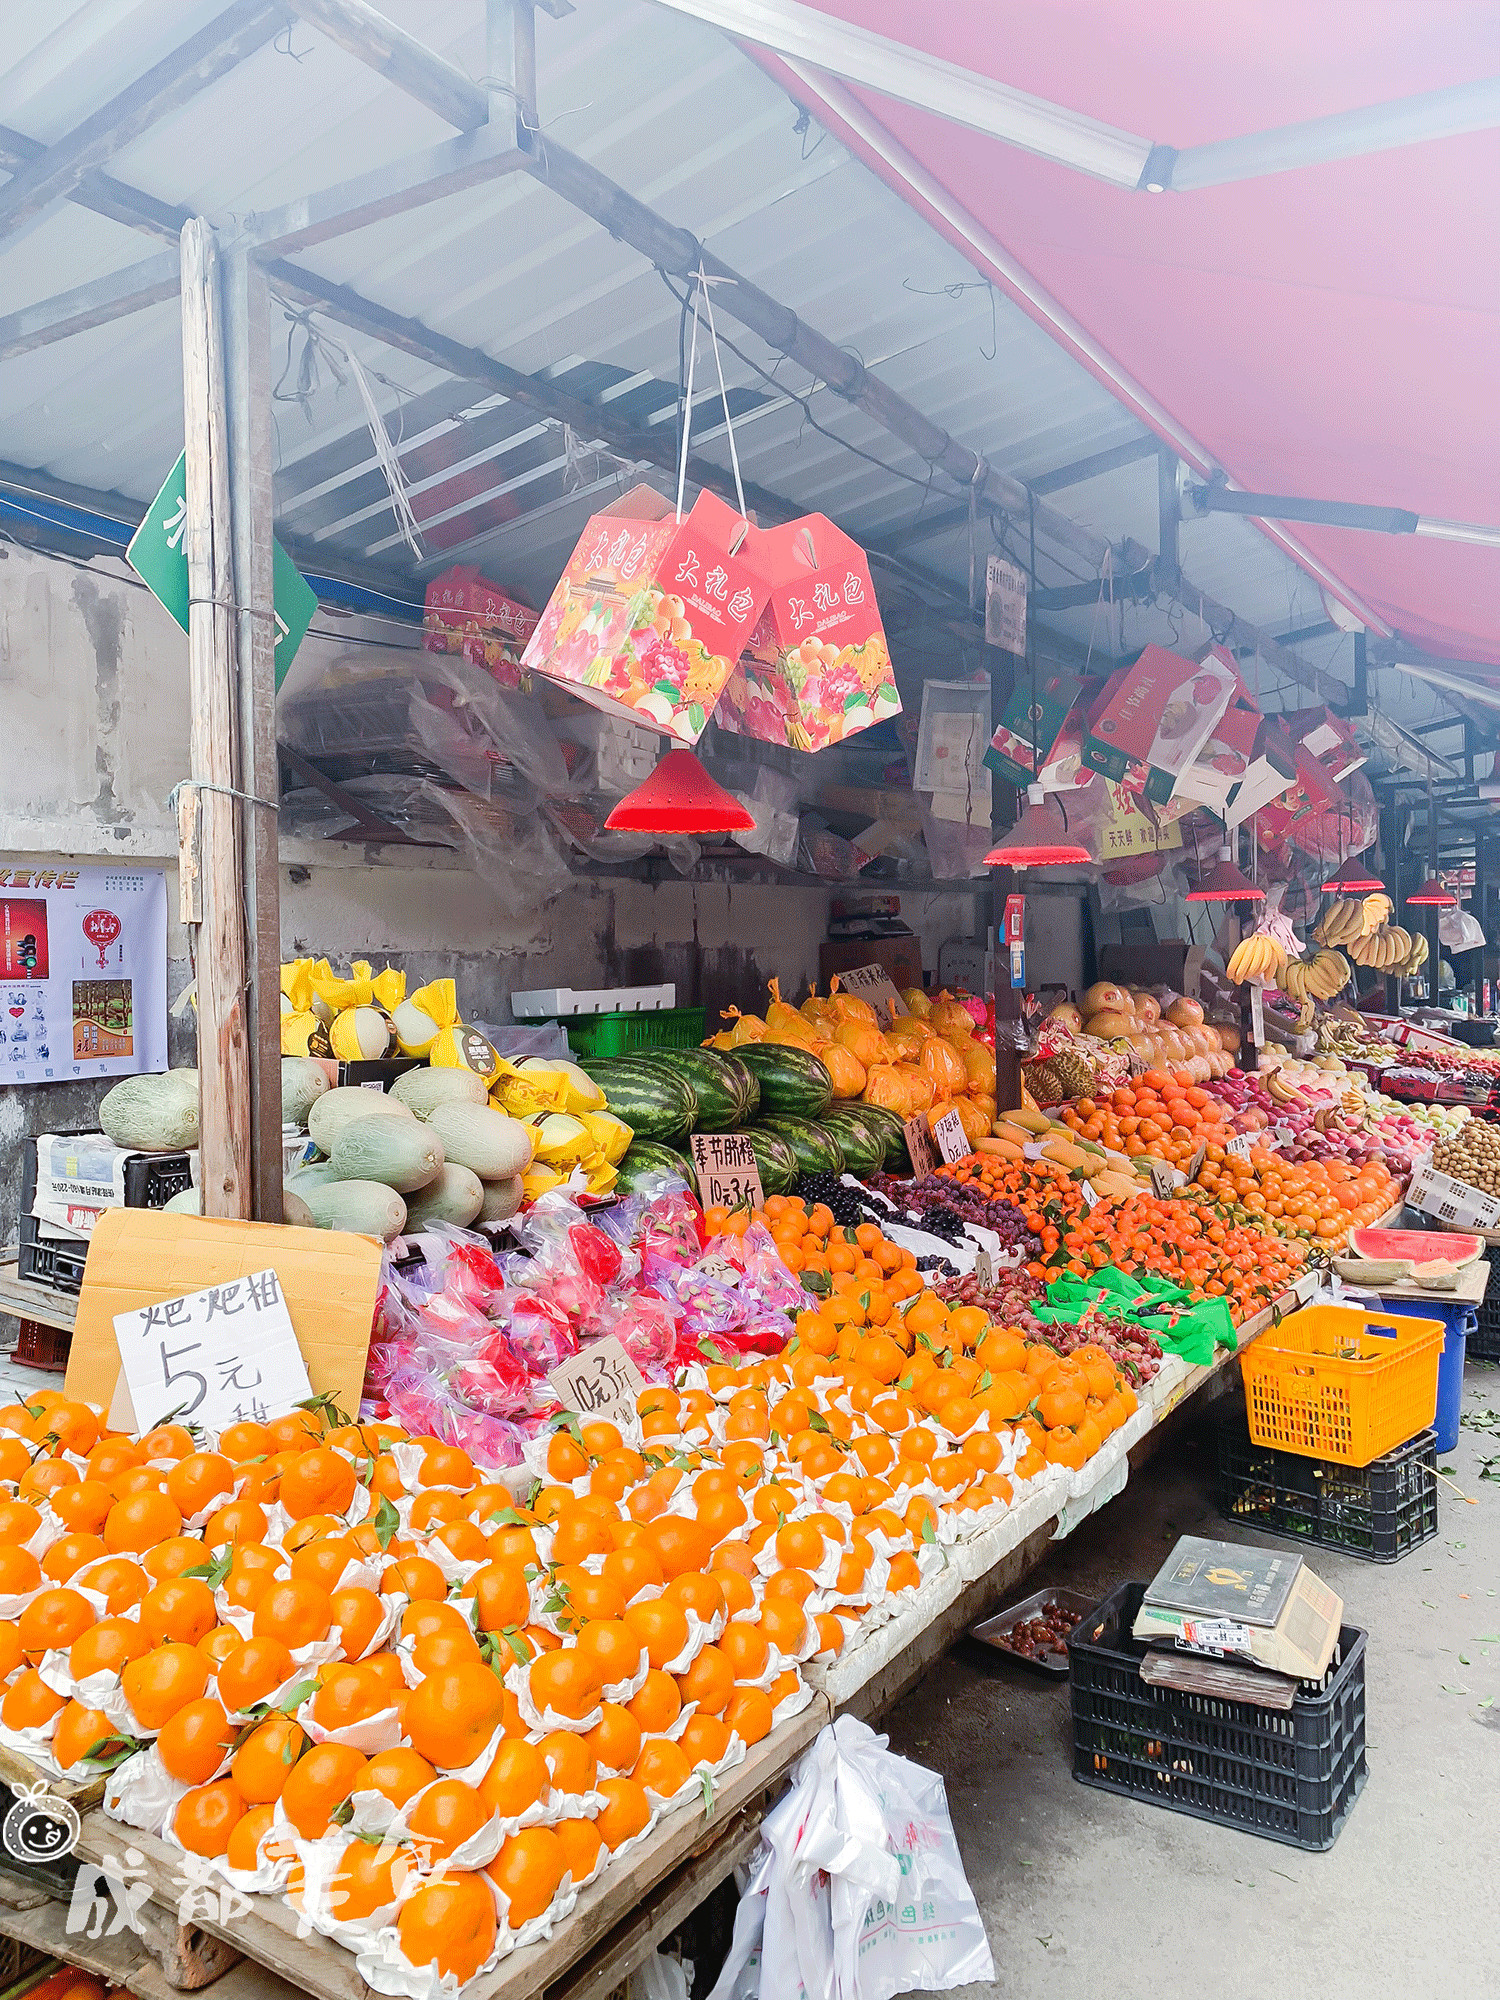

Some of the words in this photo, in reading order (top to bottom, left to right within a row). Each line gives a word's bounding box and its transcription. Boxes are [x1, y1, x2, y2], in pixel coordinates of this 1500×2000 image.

[584, 529, 647, 579] 大礼包
[675, 550, 753, 623] 大礼包
[788, 571, 864, 629] 大礼包
[160, 1341, 263, 1416] 5元
